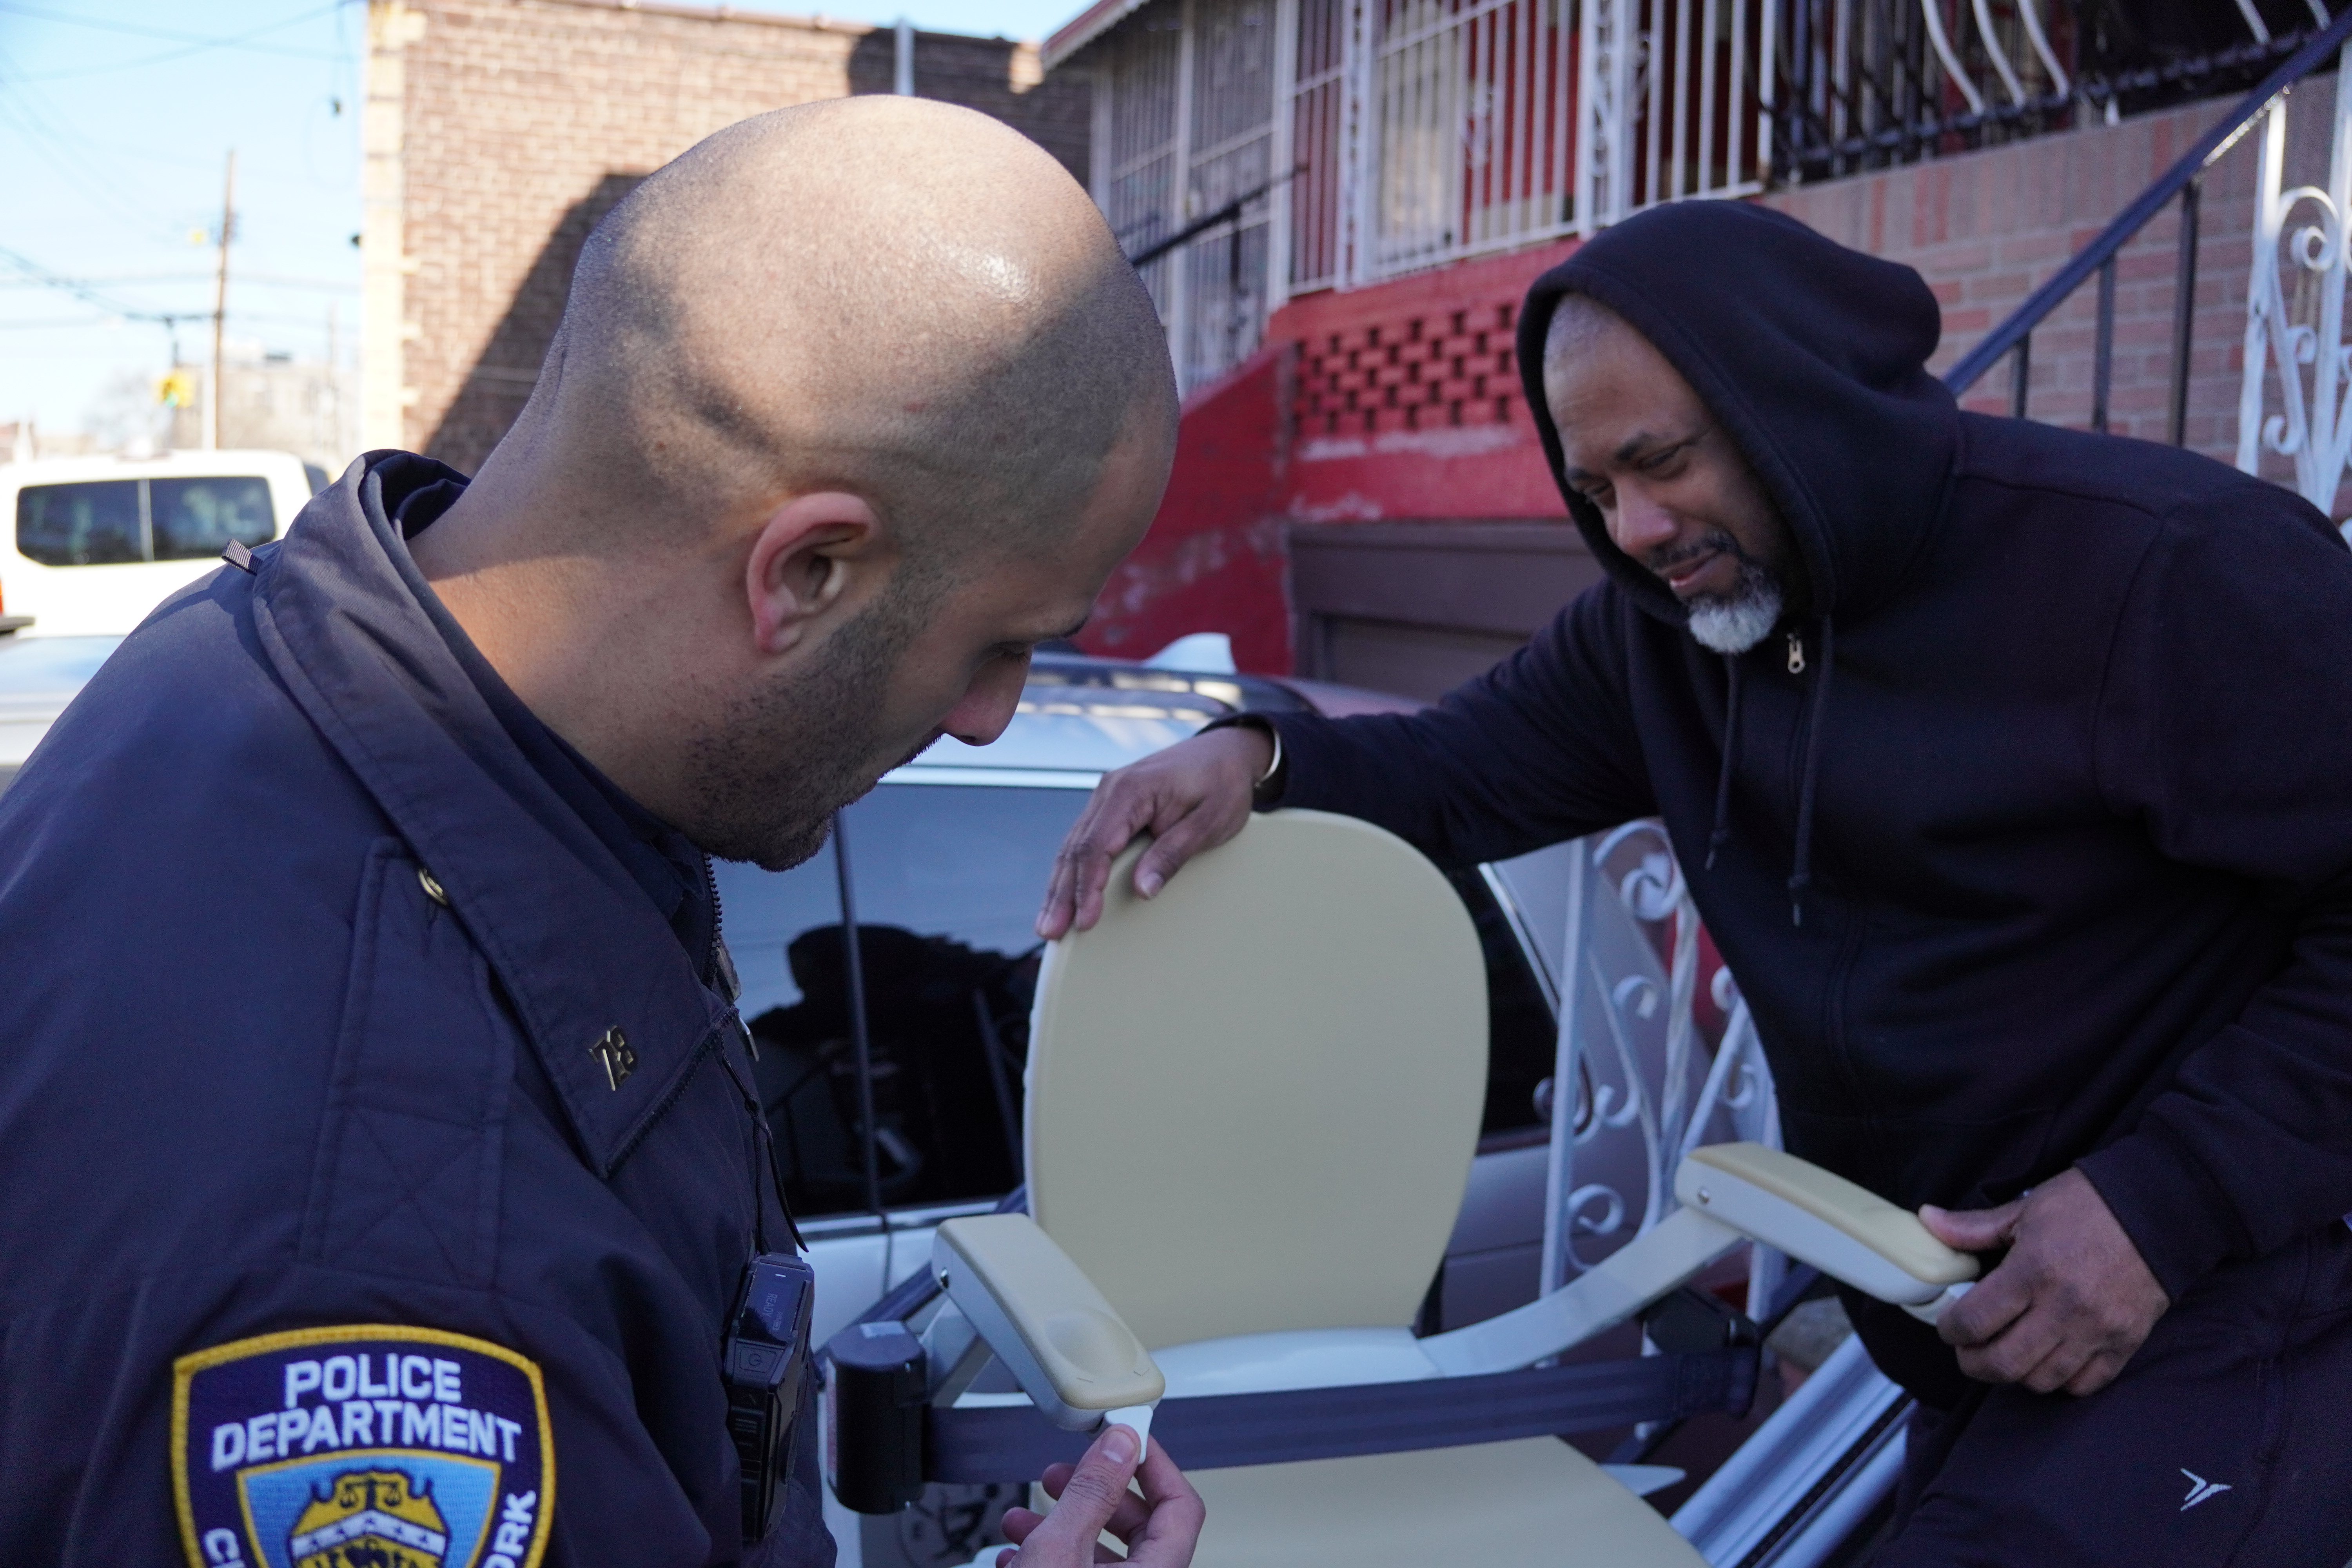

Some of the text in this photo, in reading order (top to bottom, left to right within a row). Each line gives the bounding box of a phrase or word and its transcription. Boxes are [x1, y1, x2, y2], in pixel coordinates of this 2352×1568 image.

[763, 1293, 778, 1318] READY
[285, 1353, 462, 1408] POLICE
[212, 1401, 522, 1471] DEPARTMENT
